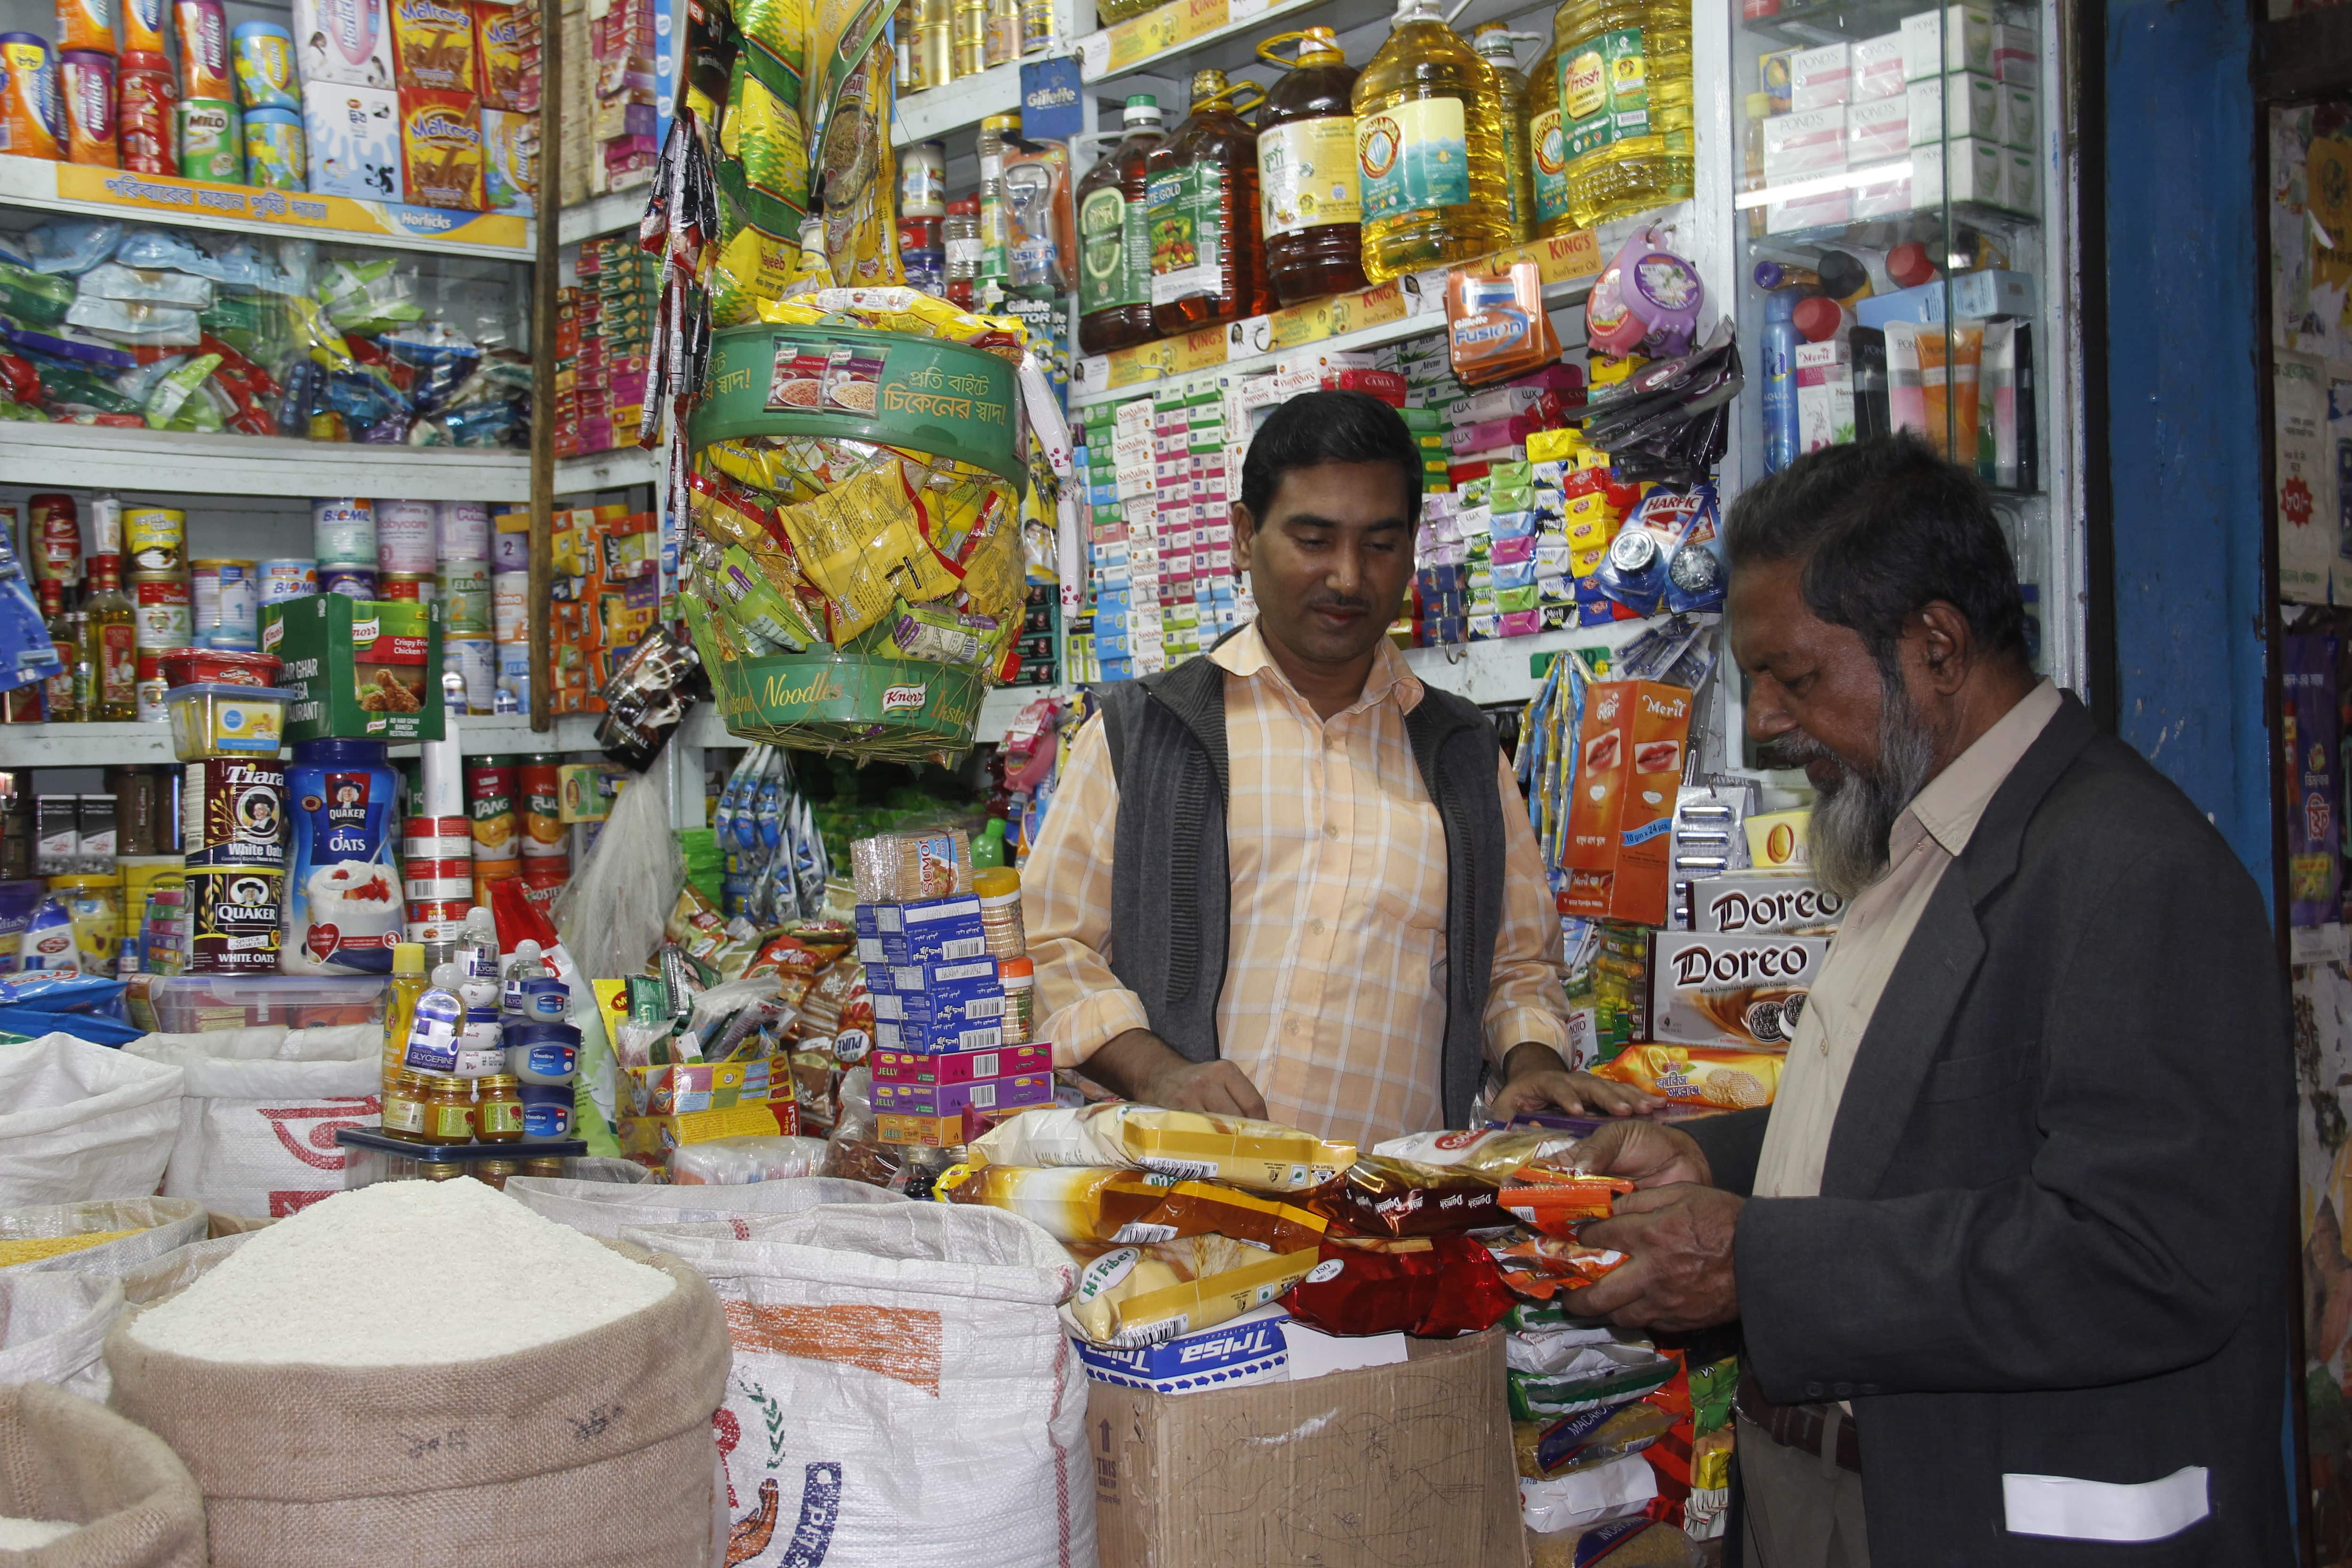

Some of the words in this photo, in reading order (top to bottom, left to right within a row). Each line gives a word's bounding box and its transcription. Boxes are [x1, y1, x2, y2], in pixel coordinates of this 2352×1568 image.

[400, 2, 470, 27] Maltova
[689, 6, 703, 22] NEW
[208, 13, 222, 69] Horlicks
[1798, 49, 1839, 69] POND'S
[1570, 65, 1601, 92] fresh
[88, 73, 104, 132] Horlicks
[1027, 88, 1076, 107] Gillette
[1855, 102, 1897, 120] POND'S
[190, 115, 225, 127] MILO
[1780, 114, 1824, 132] POND'S
[409, 119, 480, 143] Maltova
[105, 175, 192, 206] পরিবারের
[198, 191, 245, 211] মহান
[1160, 182, 1181, 203] GOLD
[401, 212, 451, 231] Horlicks
[1549, 235, 1591, 261] KING'S
[1006, 299, 1051, 313] Gillette
[1454, 315, 1488, 330] Gillette
[1454, 320, 1523, 346] Fusion
[1187, 333, 1224, 352] KING'S
[1422, 358, 1441, 372] Neem
[910, 366, 941, 391] প্রতি
[948, 371, 989, 396] বাইটে
[1364, 376, 1396, 389] CAMAY
[882, 382, 973, 419] চিকেনের
[1452, 399, 1472, 414] LUX
[1452, 431, 1472, 444] LUX
[1648, 495, 1700, 511] HARPIC
[323, 508, 371, 522] BIOMIL
[504, 541, 513, 556] 2
[451, 598, 467, 621] 2
[352, 626, 377, 637] norr
[394, 646, 421, 655] Chicken
[395, 638, 415, 647] Crispy
[296, 659, 318, 677] GHAR
[761, 670, 844, 711] Noodles
[886, 688, 925, 706] Knorr
[1643, 694, 1686, 718] Meril
[225, 764, 284, 784] Tiara
[329, 808, 366, 820] QUAKER
[472, 798, 509, 818] TANG
[1626, 834, 1633, 842] 10
[1634, 834, 1643, 844] gm
[1648, 825, 1657, 835] 24
[228, 843, 264, 857] White
[266, 843, 282, 856] Oats
[329, 837, 366, 852] OATS
[1573, 874, 1589, 885] Meril
[220, 906, 276, 921] QUAKER
[1710, 890, 1844, 931] Doreo
[236, 936, 260, 945] QUICK
[387, 933, 397, 947] 3
[218, 953, 252, 963] WHITE
[253, 953, 275, 963] OATS
[1672, 945, 1807, 987] Doreo
[836, 1038, 863, 1054] PURE
[411, 1051, 454, 1065] GLYCERINE
[877, 1067, 898, 1076] JELLY
[874, 1098, 895, 1107] JELLY
[883, 1129, 902, 1138] JELLY
[1439, 1194, 1464, 1209] Danish
[1468, 1193, 1492, 1209] Danish
[1081, 1273, 1102, 1297] Hi
[1098, 1250, 1132, 1277] Fiber
[1316, 1264, 1331, 1275] ISO
[1181, 1328, 1272, 1364] Trisa
[1097, 1457, 1117, 1478] THIS
[795, 1504, 829, 1552] Ltd
